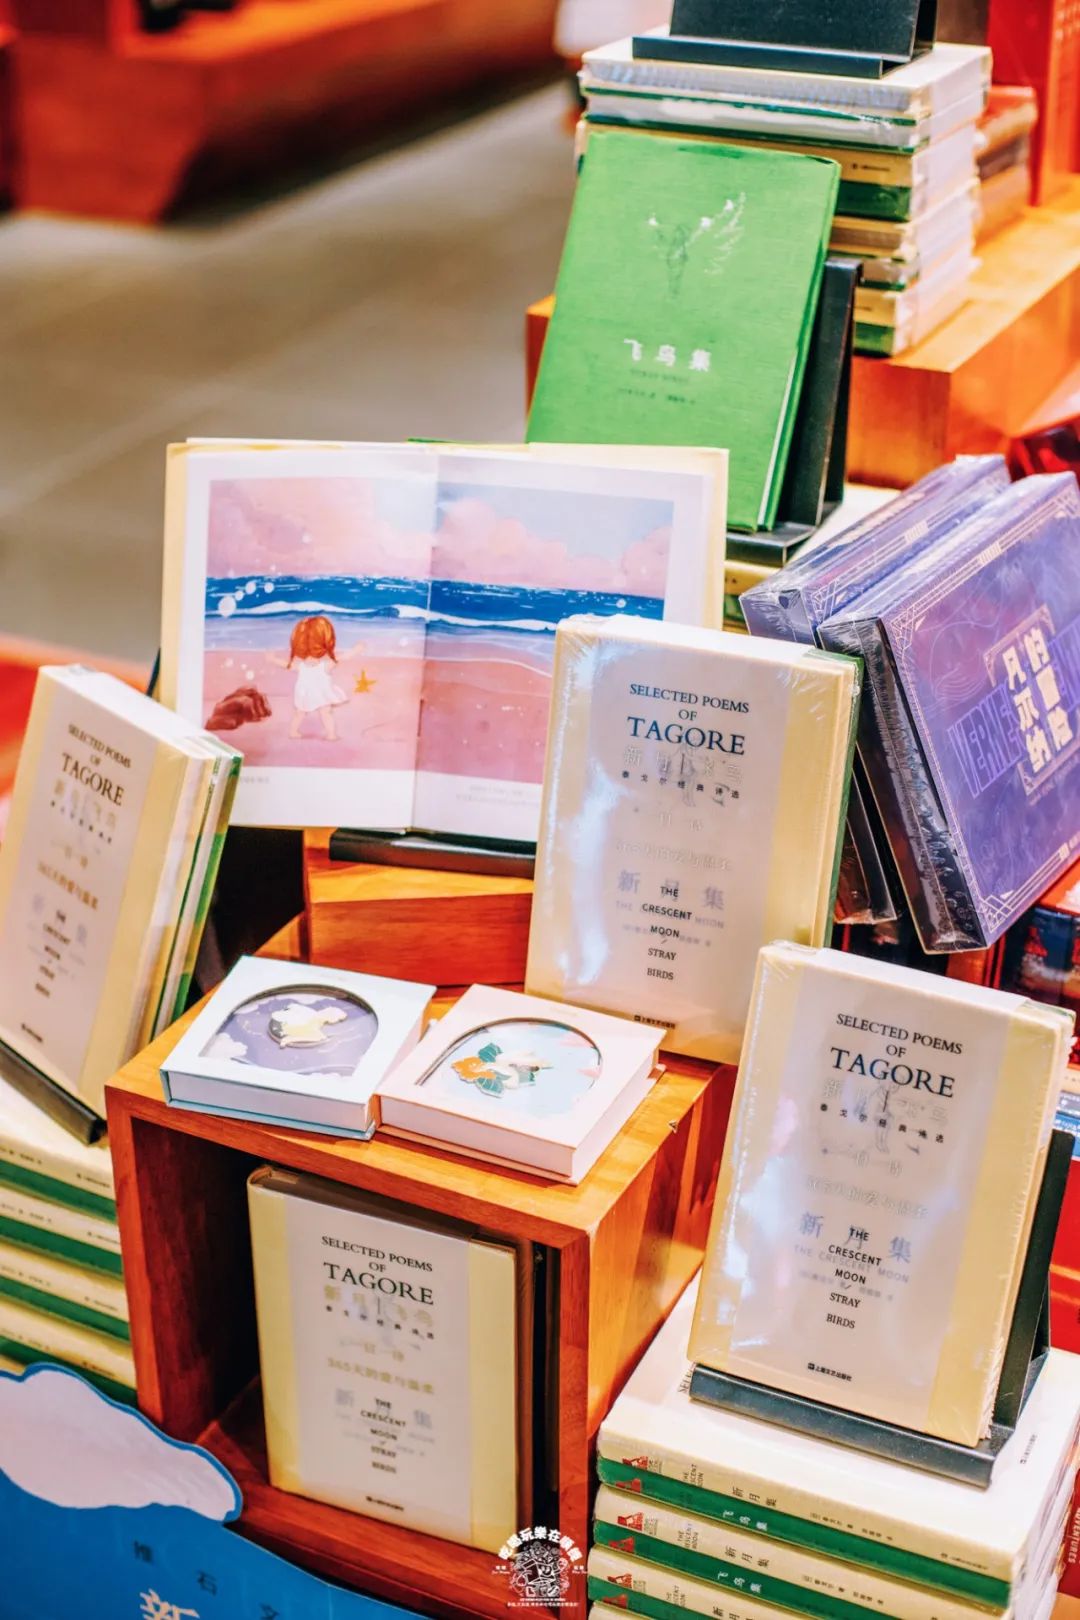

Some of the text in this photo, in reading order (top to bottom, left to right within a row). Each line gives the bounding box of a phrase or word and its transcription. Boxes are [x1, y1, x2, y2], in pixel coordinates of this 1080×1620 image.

[623, 338, 711, 373] 飞鸟集
[629, 683, 750, 713] SELECTED POEMS
[678, 709, 698, 721] OF
[627, 716, 746, 756] TAGORE
[61, 752, 125, 806] TAGORE
[660, 886, 679, 898] THE
[641, 903, 692, 920] CRESCENT
[650, 925, 680, 938] MOON
[648, 947, 677, 960] STRAY
[647, 967, 674, 980] BIRDS
[836, 1013, 963, 1055] SELECTED POEMS
[886, 1044, 907, 1058] OF
[830, 1047, 955, 1098] TAGORE
[849, 1227, 869, 1241] THE
[321, 1236, 433, 1272] SELECTED POEMS
[828, 1244, 882, 1266] CRESCENT
[368, 1261, 387, 1273] OF
[835, 1268, 866, 1285] MOON
[323, 1262, 434, 1305] TAGORE
[829, 1292, 861, 1308] STRAY
[826, 1313, 855, 1329] BIRDS
[732, 1486, 777, 1507] 新月集
[722, 1510, 768, 1531] 飞鸟集
[724, 1545, 770, 1568] 新月集
[717, 1570, 763, 1594] 飞鸟集
[712, 1605, 756, 1620] 新月
